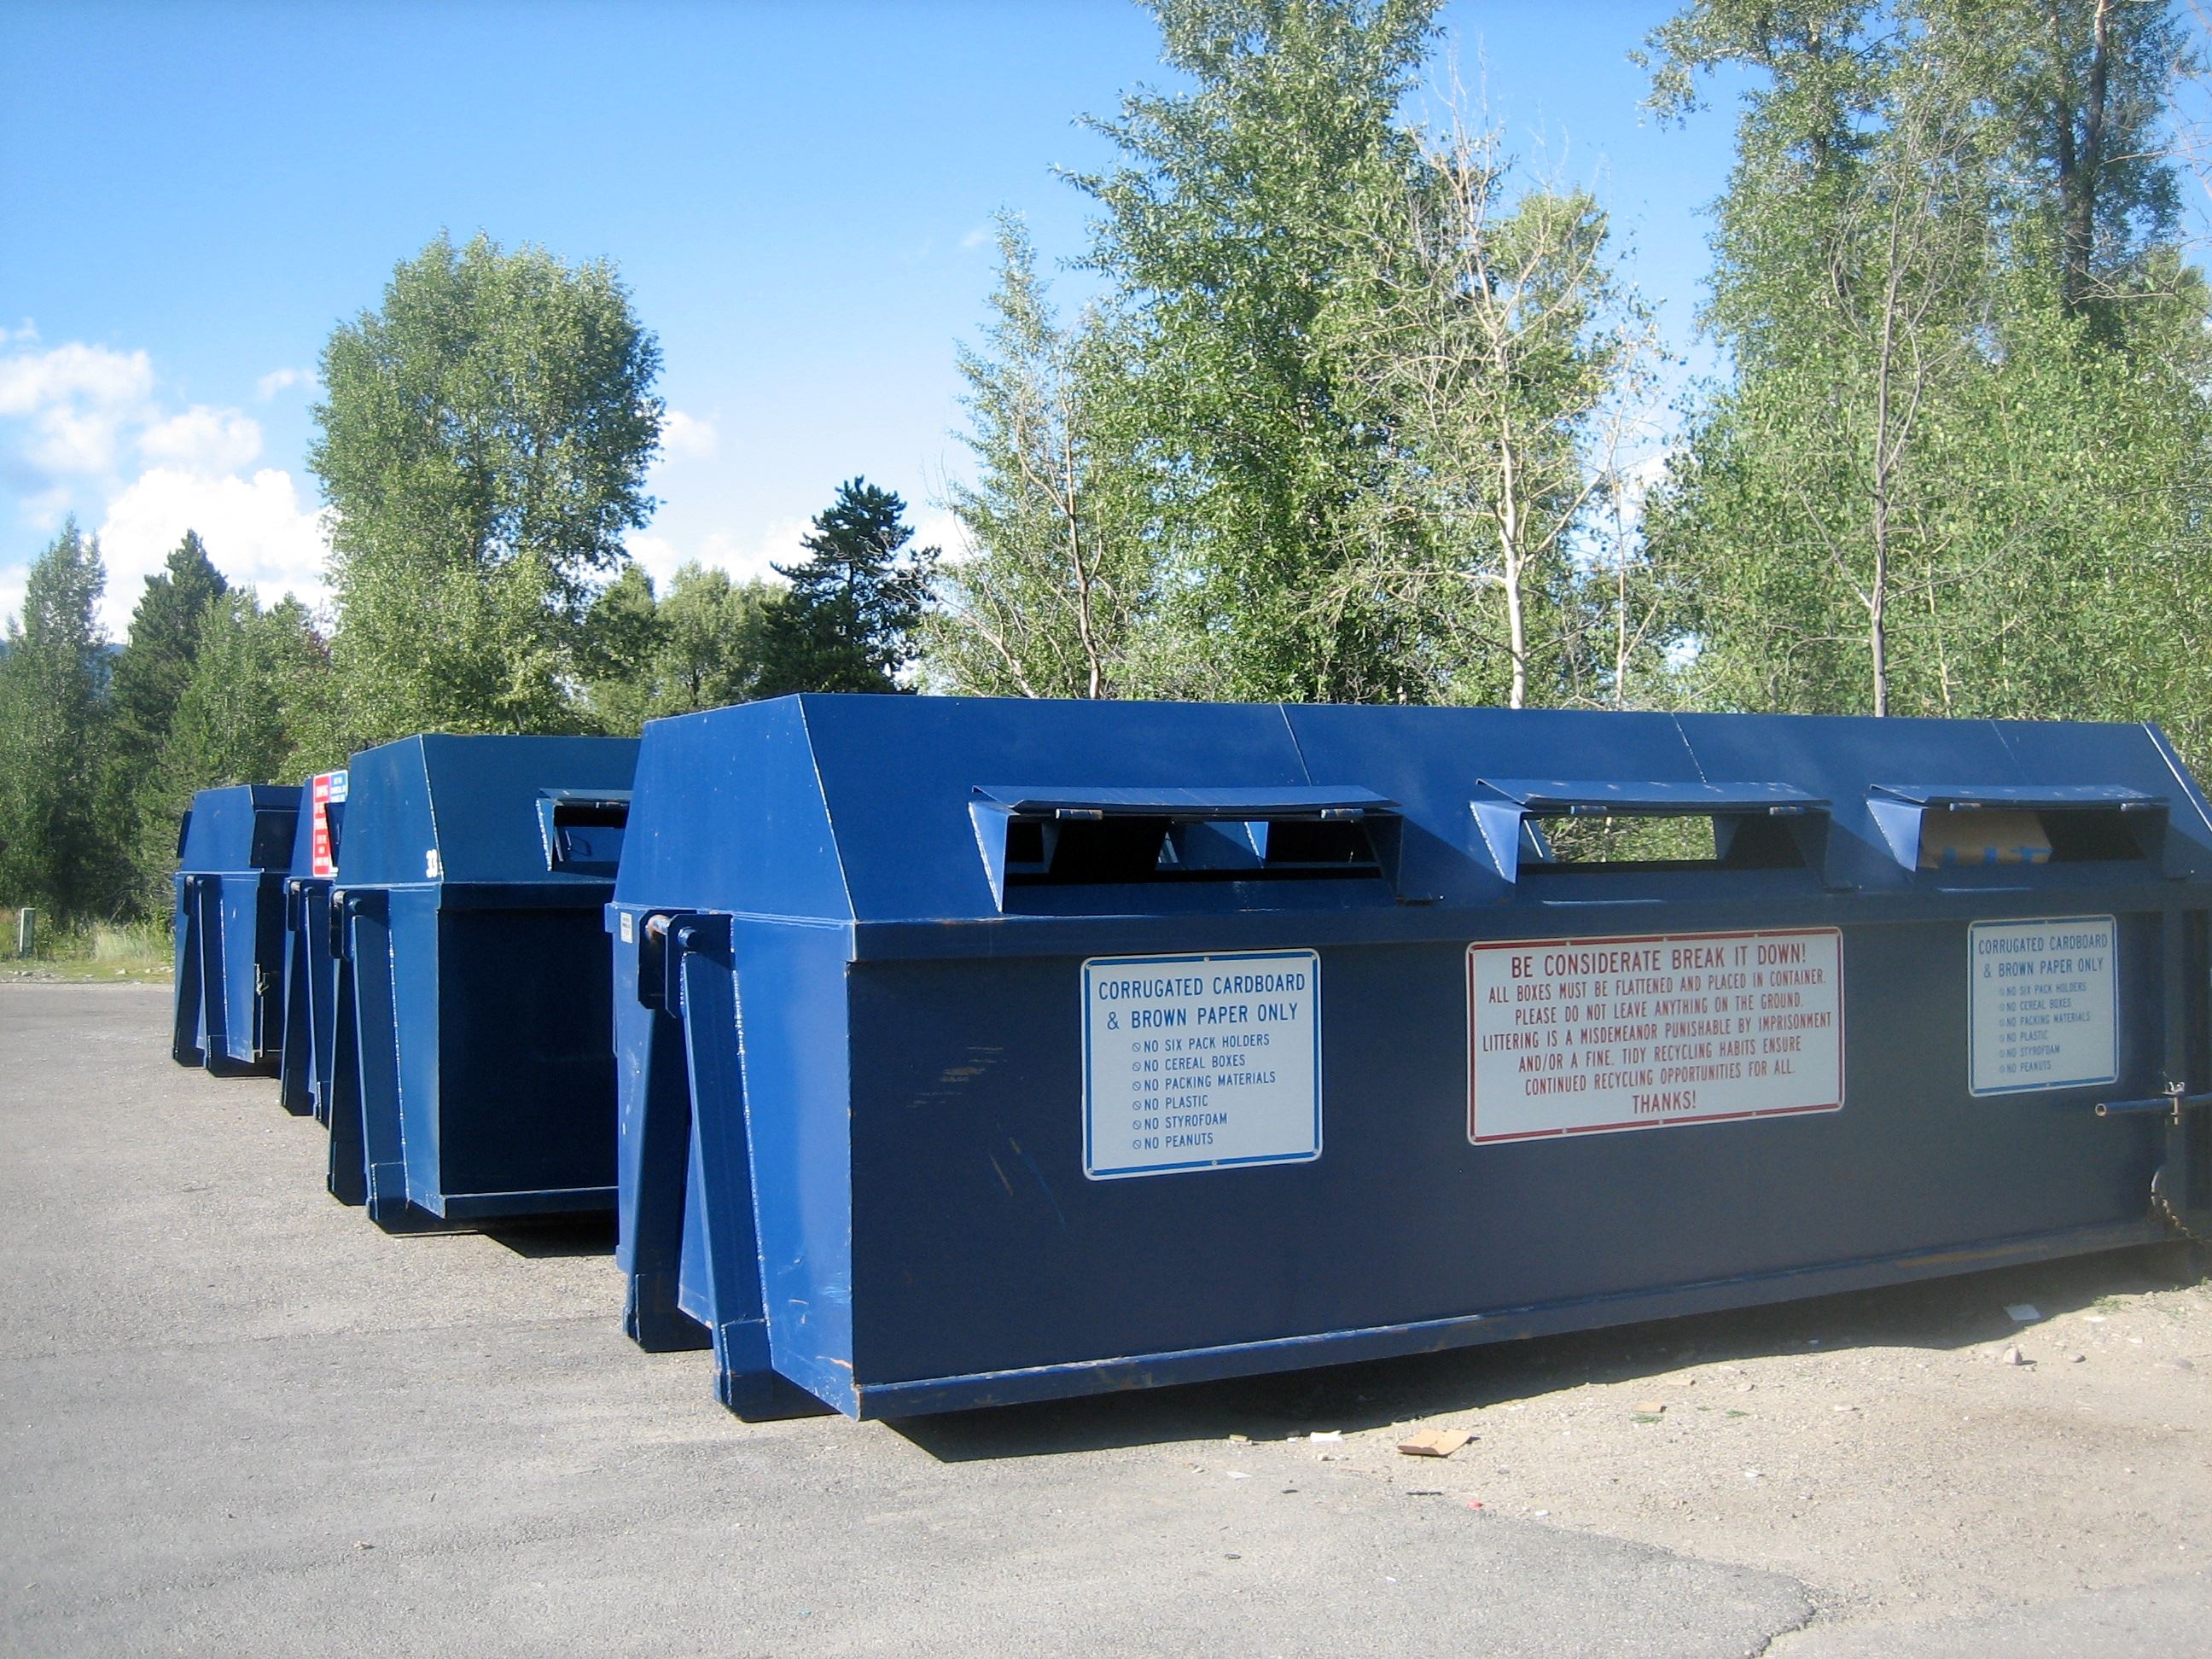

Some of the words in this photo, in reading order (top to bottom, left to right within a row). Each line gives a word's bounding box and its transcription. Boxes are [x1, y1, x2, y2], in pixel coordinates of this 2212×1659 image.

[1979, 937, 2044, 955] CORRUGATED
[2050, 934, 2107, 951] CARDBOARD
[1512, 956, 1533, 978] BE
[1545, 950, 1661, 976] CONSIDERATE
[1673, 947, 1725, 969] BREAK
[1735, 946, 1748, 966] IT
[1758, 942, 1805, 965] DOWN!
[1983, 963, 1992, 978] &
[1999, 962, 2034, 977] BROWN
[2040, 959, 2072, 974] PAPER
[2078, 958, 2103, 972] ONLY
[1099, 978, 1202, 1000] CORRUGATED
[1214, 974, 1305, 994] CARDBOARD
[1489, 987, 1509, 1004] ALL
[1517, 984, 1551, 1002] BOXES
[1560, 981, 1586, 999] MUST
[1595, 981, 1608, 997] BE
[1616, 977, 1673, 996] FLATTENED
[1680, 975, 1701, 992] AND
[1708, 973, 1746, 990] PLACED
[1753, 972, 1762, 987] IN
[1770, 969, 1825, 987] CONTAINER.
[1108, 1011, 1119, 1030] &
[1132, 1009, 1185, 1028] BROWN
[1198, 1005, 1248, 1025] PAPER
[1258, 1003, 1297, 1022] ONLY
[1516, 1007, 1557, 1025] PLEASE
[1565, 1005, 1578, 1022] DO
[1587, 1004, 1606, 1021] NOT
[1615, 1001, 1647, 1019] LEAVE
[1655, 998, 1708, 1016] ANYTHING
[1715, 997, 1727, 1012] ON
[1736, 995, 1754, 1010] THE
[1761, 992, 1802, 1010] GROUND.
[1144, 1040, 1158, 1052] NO
[1165, 1039, 1182, 1051] SIX
[1189, 1037, 1215, 1050] PACK
[1223, 1033, 1269, 1047] HOLDERS
[1483, 1032, 1539, 1051] LITTERING
[1547, 1030, 1557, 1046] IS
[1566, 1029, 1572, 1045] A
[1580, 1024, 1657, 1045] MISDEMEANOR
[1666, 1019, 1731, 1038] PUNISHABLE
[1738, 1017, 1751, 1033] BY
[1759, 1011, 1831, 1031] IMPRISONMENT
[1144, 1060, 1158, 1072] NO
[1166, 1057, 1206, 1070] CEREAL
[1212, 1054, 1245, 1068] BOXES
[1519, 1053, 1563, 1072] AND/OR
[1571, 1052, 1578, 1068] A
[1586, 1050, 1614, 1067] FINE.
[1622, 1047, 1646, 1064] TIDY
[1655, 1042, 1712, 1062] RECYCLING
[1720, 1039, 1755, 1057] HABITS
[1763, 1036, 1801, 1053] ENSURE
[1144, 1079, 1158, 1091] NO
[1166, 1075, 1211, 1090] PACKING
[1218, 1071, 1275, 1086] MATERIALS
[1526, 1075, 1586, 1096] CONTINUED
[1594, 1069, 1653, 1089] RECYCLING
[1661, 1062, 1741, 1084] OPPORTUNITIES
[1749, 1061, 1767, 1077] FOR
[1774, 1059, 1795, 1074] ALL.
[1144, 1098, 1159, 1110] NO
[1166, 1095, 1208, 1109] PLASTIC
[1633, 1090, 1696, 1114] THANKS!
[1144, 1118, 1159, 1130] NO
[1166, 1113, 1227, 1128] STYROFOAM
[1144, 1137, 1159, 1150] NO
[1166, 1132, 1213, 1148] PEANUTS
